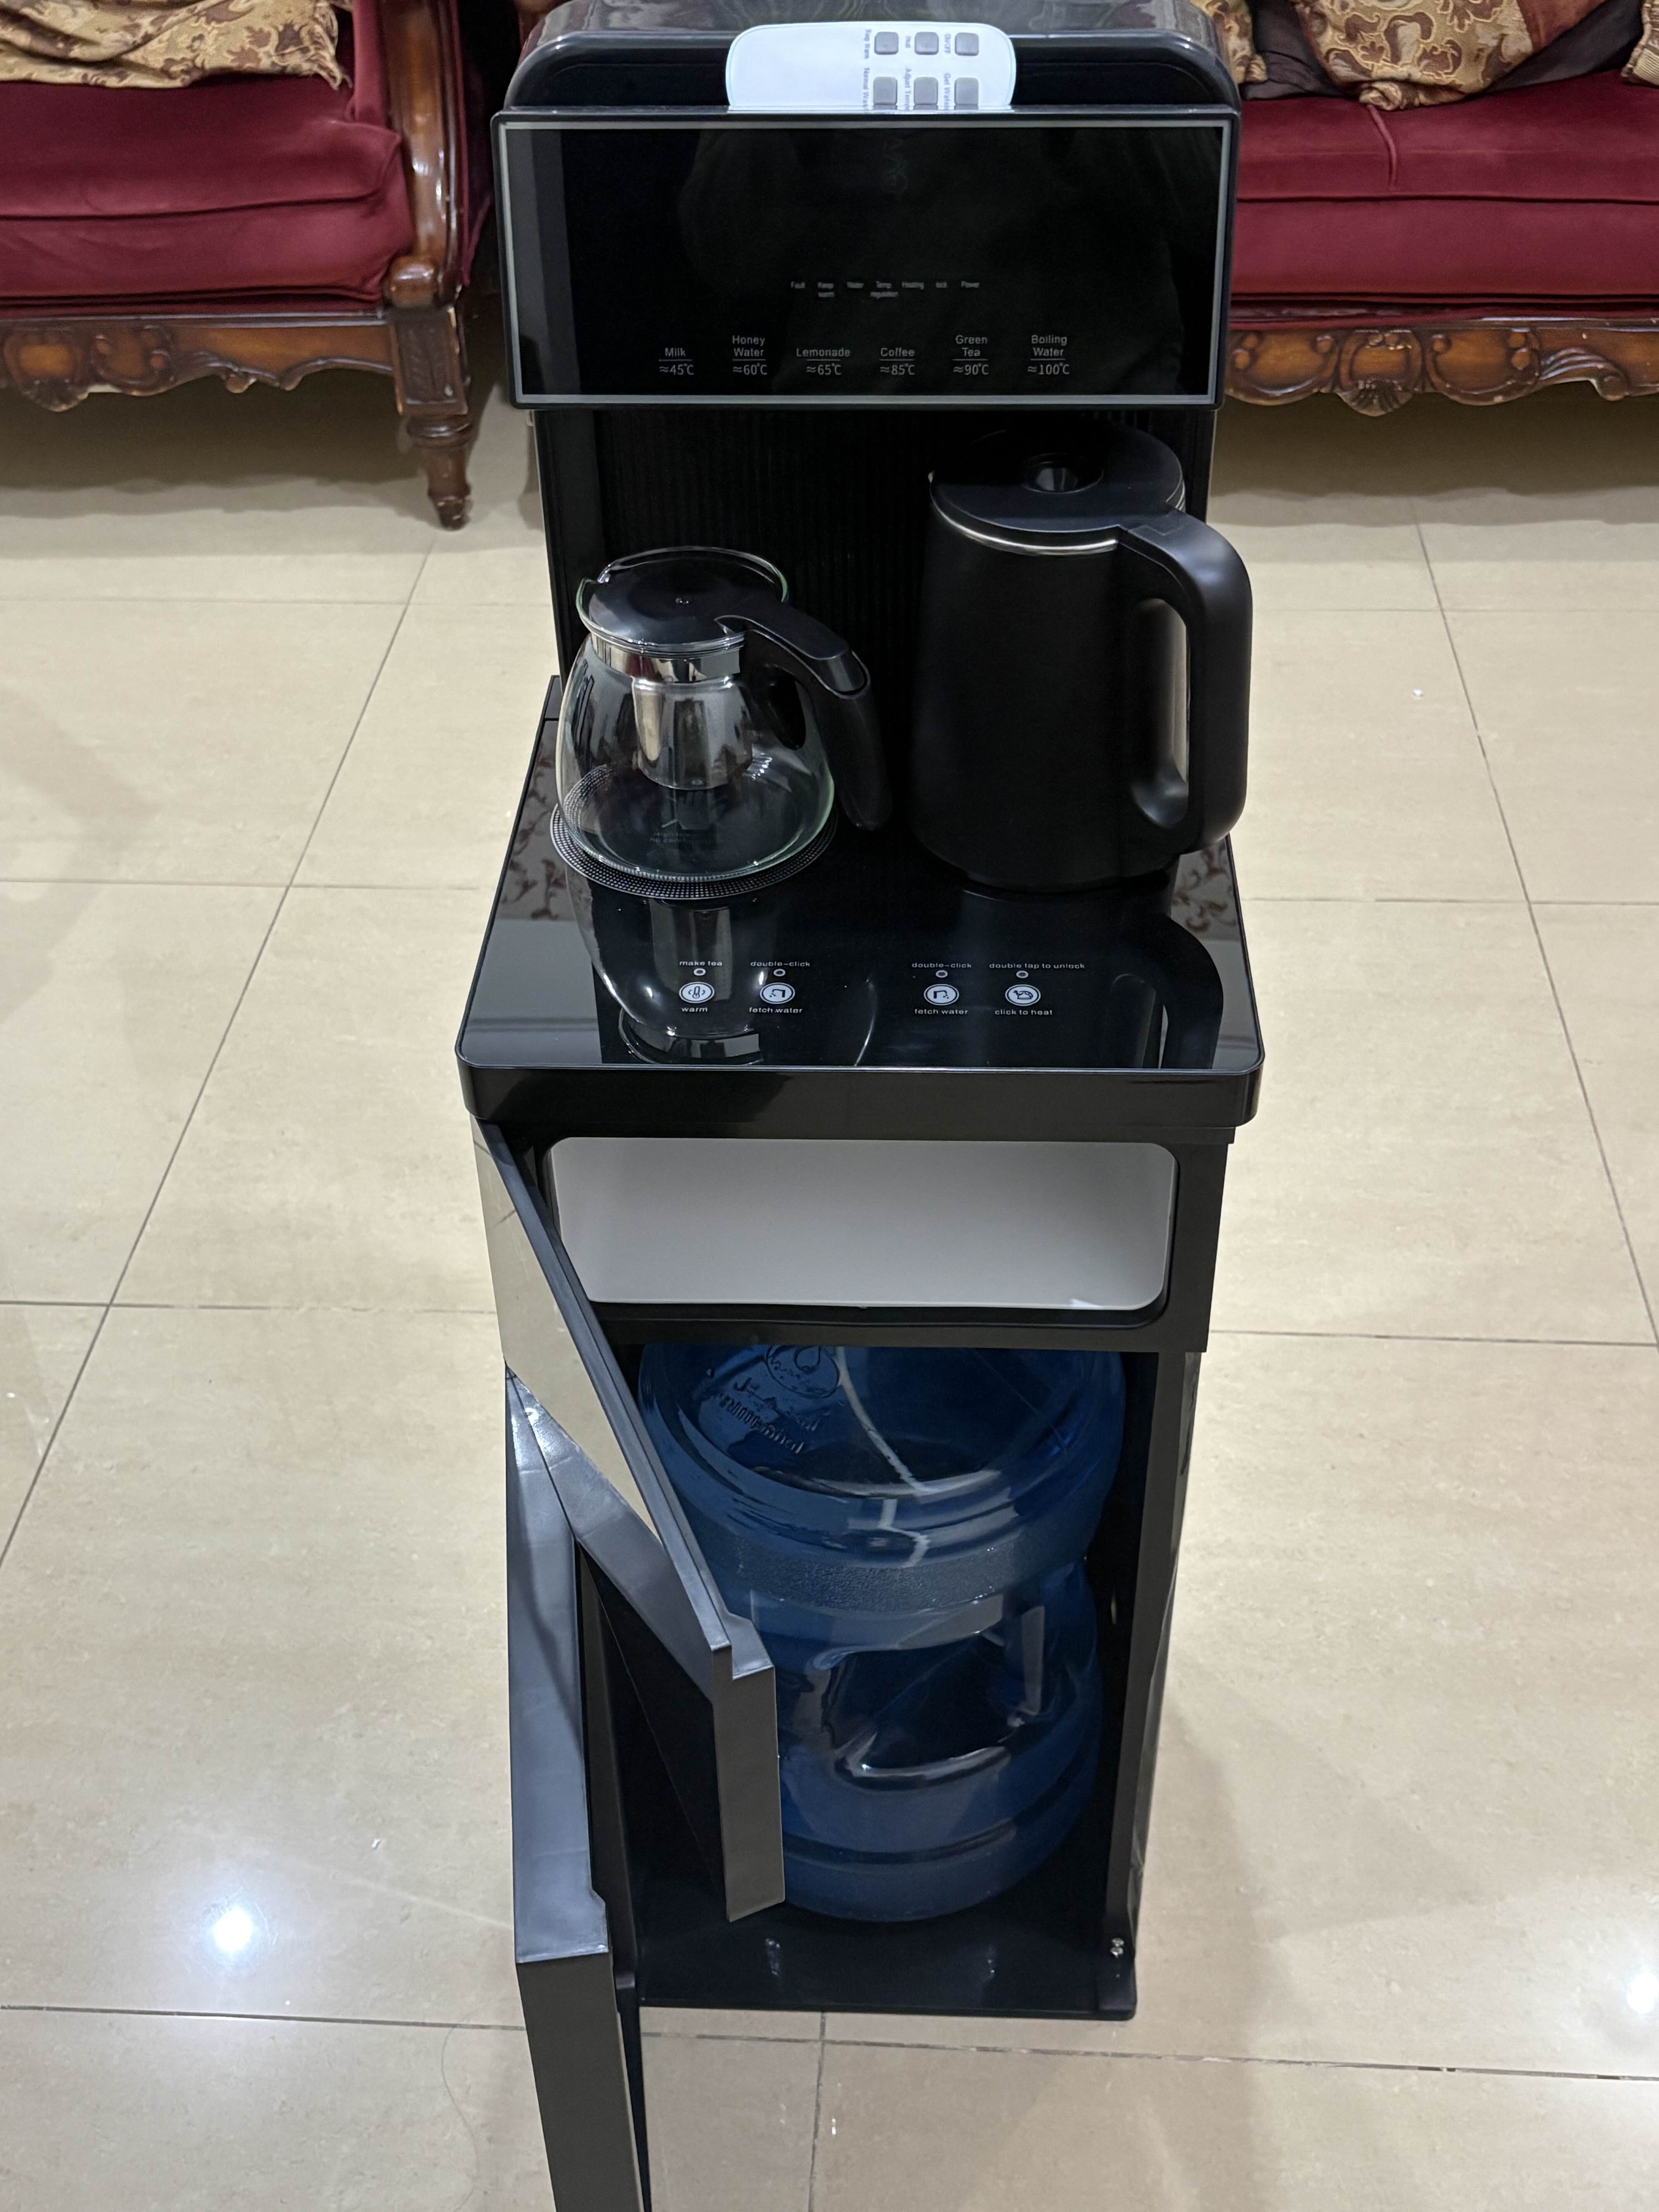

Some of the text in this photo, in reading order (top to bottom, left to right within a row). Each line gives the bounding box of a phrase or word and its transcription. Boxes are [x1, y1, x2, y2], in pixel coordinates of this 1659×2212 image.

[732, 335, 765, 347] Honey
[955, 335, 988, 344] Green
[1031, 335, 1067, 346] Boiling
[665, 347, 685, 357] Milk
[733, 347, 764, 357] Water
[796, 348, 850, 357] Lemonade
[880, 347, 915, 357] Coffee
[962, 347, 981, 357] Tea
[1033, 347, 1064, 357] Water
